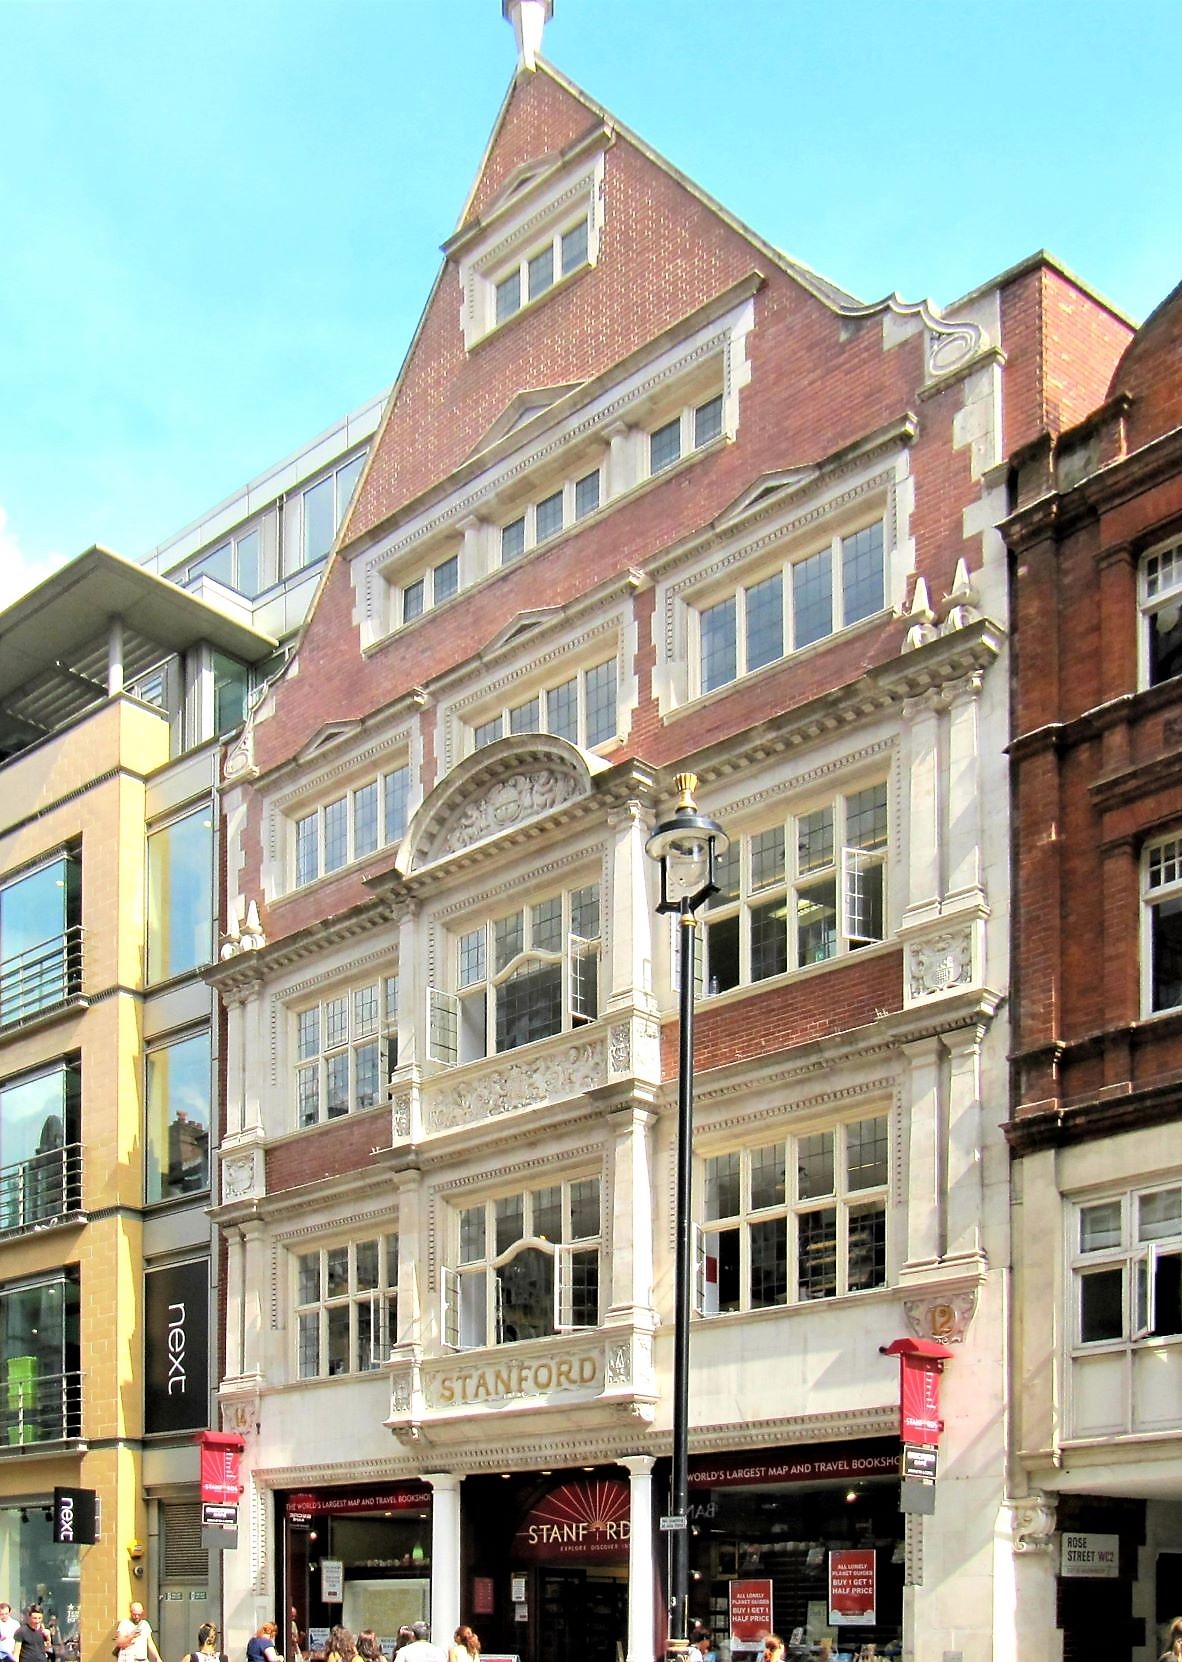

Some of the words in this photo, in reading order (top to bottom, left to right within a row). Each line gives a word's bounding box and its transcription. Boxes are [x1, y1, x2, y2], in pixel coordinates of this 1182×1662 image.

[168, 1302, 187, 1396] next
[439, 1356, 598, 1402] STANFORD
[687, 1471, 725, 1482] WORLD'S
[726, 1467, 767, 1479] LARGEST
[768, 1464, 789, 1476] MAP
[790, 1463, 812, 1474] AND
[814, 1460, 849, 1472] TRAVEL
[851, 1456, 900, 1470] BOOKSHO
[296, 1501, 321, 1510] WORLD'S
[322, 1499, 347, 1509] LARGEST
[347, 1498, 360, 1506] MAP
[361, 1497, 375, 1506] AND
[376, 1495, 397, 1505] TRAVEL
[61, 1497, 74, 1541] next
[560, 1544, 587, 1552] EXPLORE
[590, 1543, 618, 1551] DISCOVER
[1067, 1536, 1088, 1549] ROSE
[1067, 1550, 1095, 1562] STREET
[1097, 1551, 1114, 1562] WC2
[832, 1578, 847, 1586] BUY
[853, 1578, 868, 1586] GET
